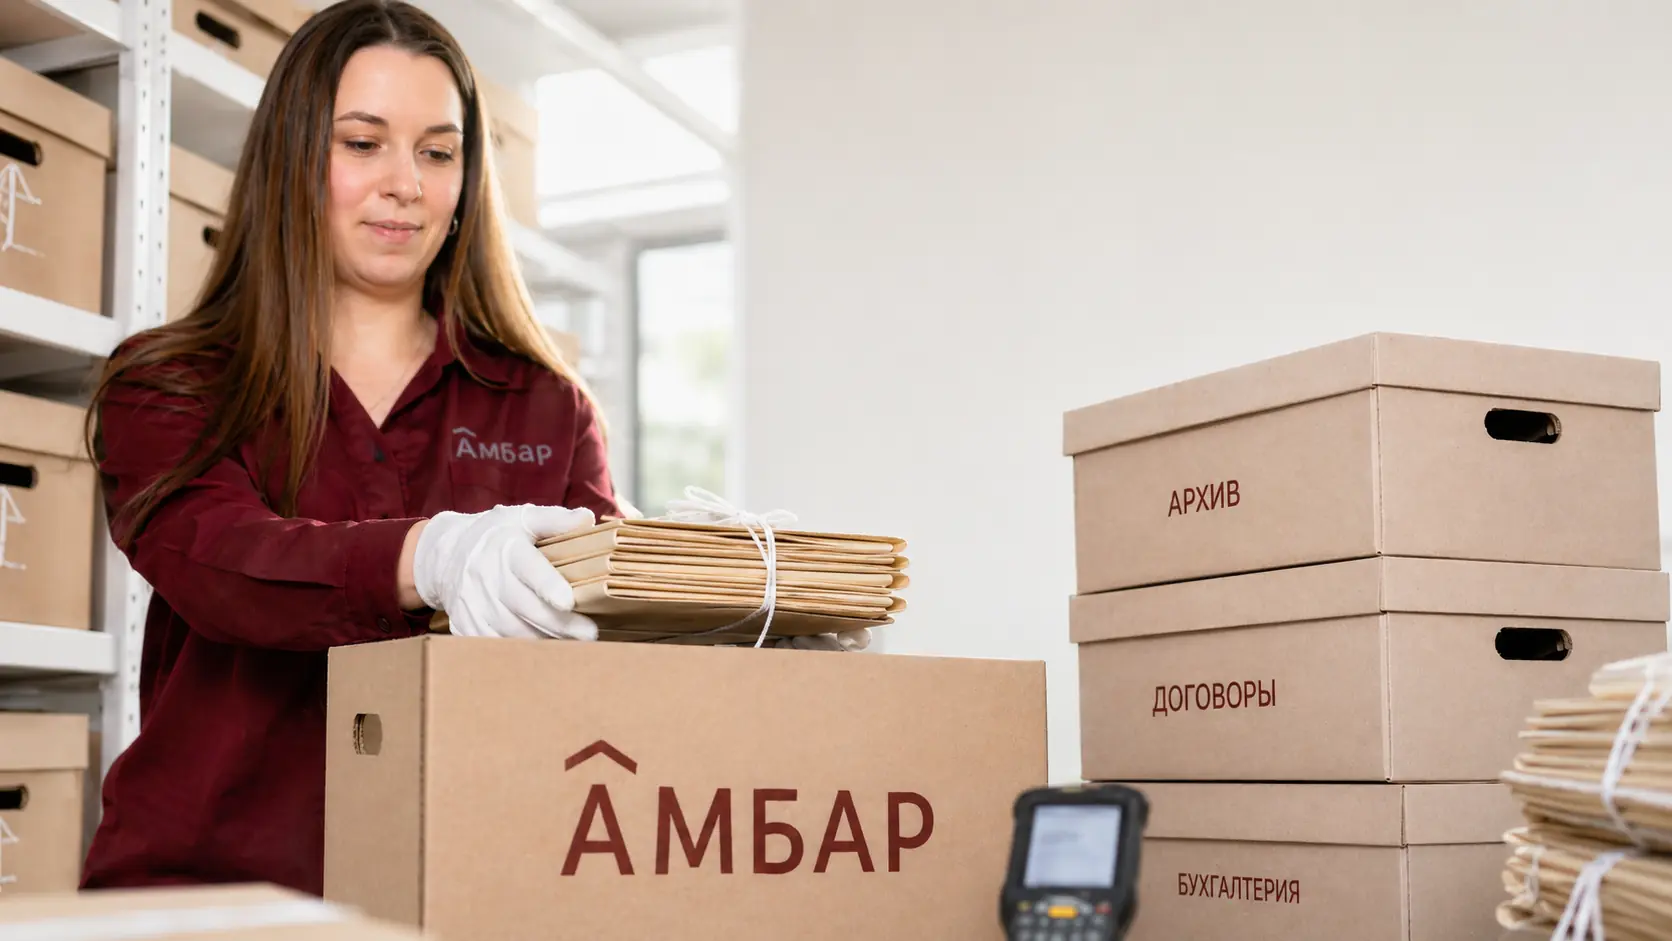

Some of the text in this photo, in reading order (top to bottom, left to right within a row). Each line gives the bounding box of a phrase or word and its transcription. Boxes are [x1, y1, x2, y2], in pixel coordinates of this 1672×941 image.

[1168, 480, 1240, 517] АРХИВ
[1152, 679, 1276, 717] ДОГОВОРЫ
[1178, 873, 1300, 904] БУХГАЛТЕРИЯ
